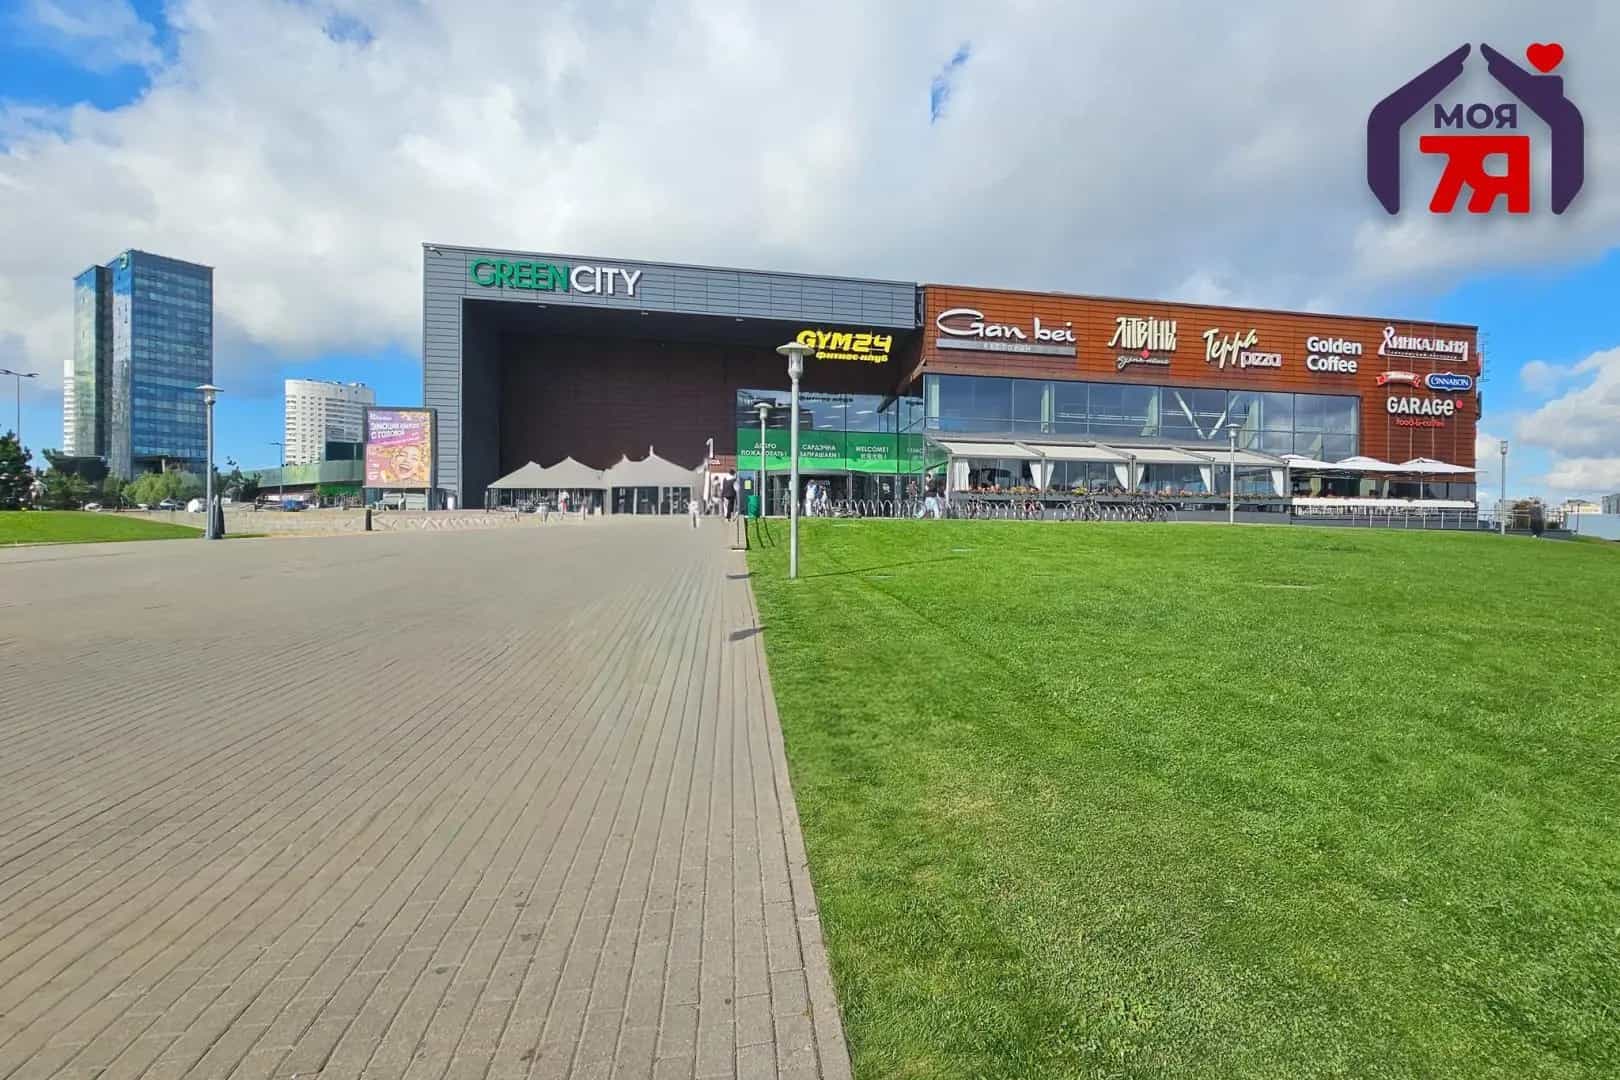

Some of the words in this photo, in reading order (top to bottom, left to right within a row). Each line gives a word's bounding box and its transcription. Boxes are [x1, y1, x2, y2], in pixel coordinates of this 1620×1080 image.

[936, 308, 1028, 340] Gan
[1033, 316, 1077, 342] bei
[796, 330, 892, 353] GYM24
[1306, 335, 1363, 356] Golden
[1240, 351, 1282, 369] pizza
[1306, 354, 1358, 373] Coffee
